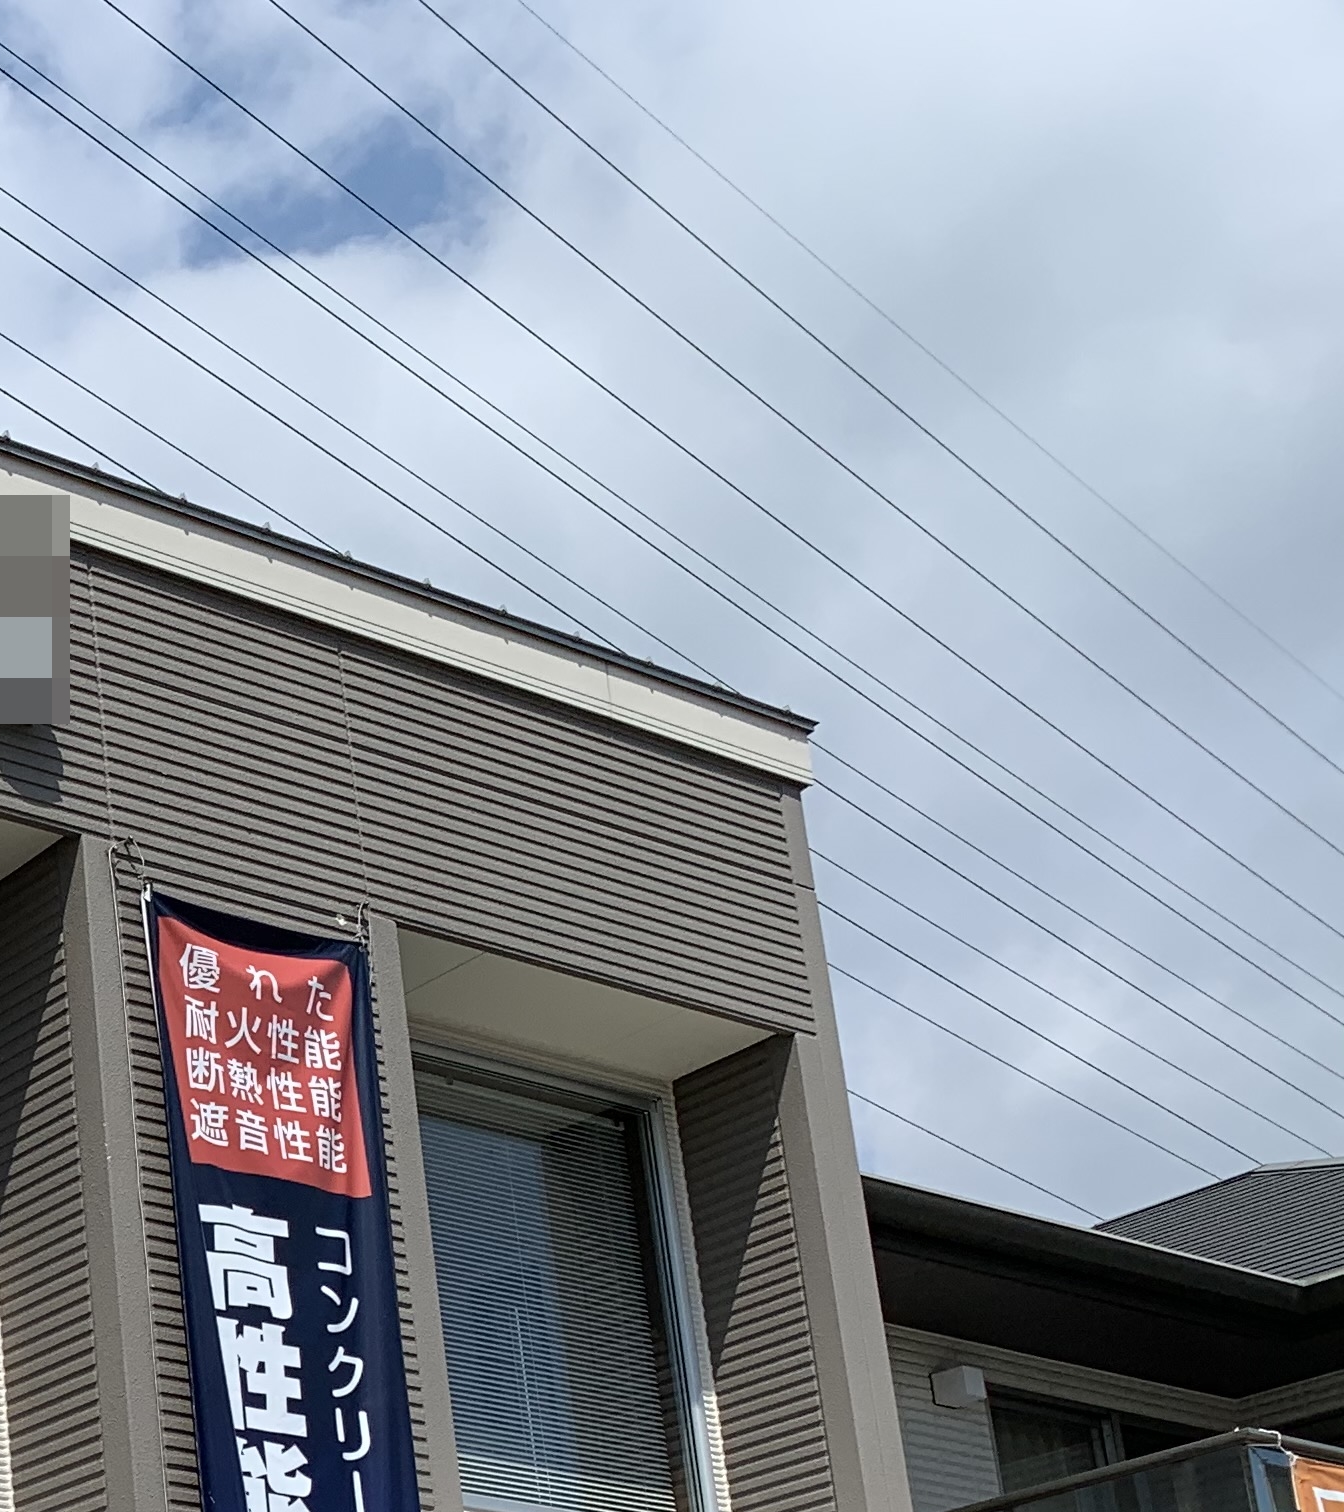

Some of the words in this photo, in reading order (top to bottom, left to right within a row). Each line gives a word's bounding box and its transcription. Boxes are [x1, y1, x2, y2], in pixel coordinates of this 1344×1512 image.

[179, 943, 334, 1022] 優れた
[184, 995, 342, 1071] 耐火性能
[186, 1046, 343, 1123] 断熱性能
[189, 1098, 348, 1174] 遮音性能
